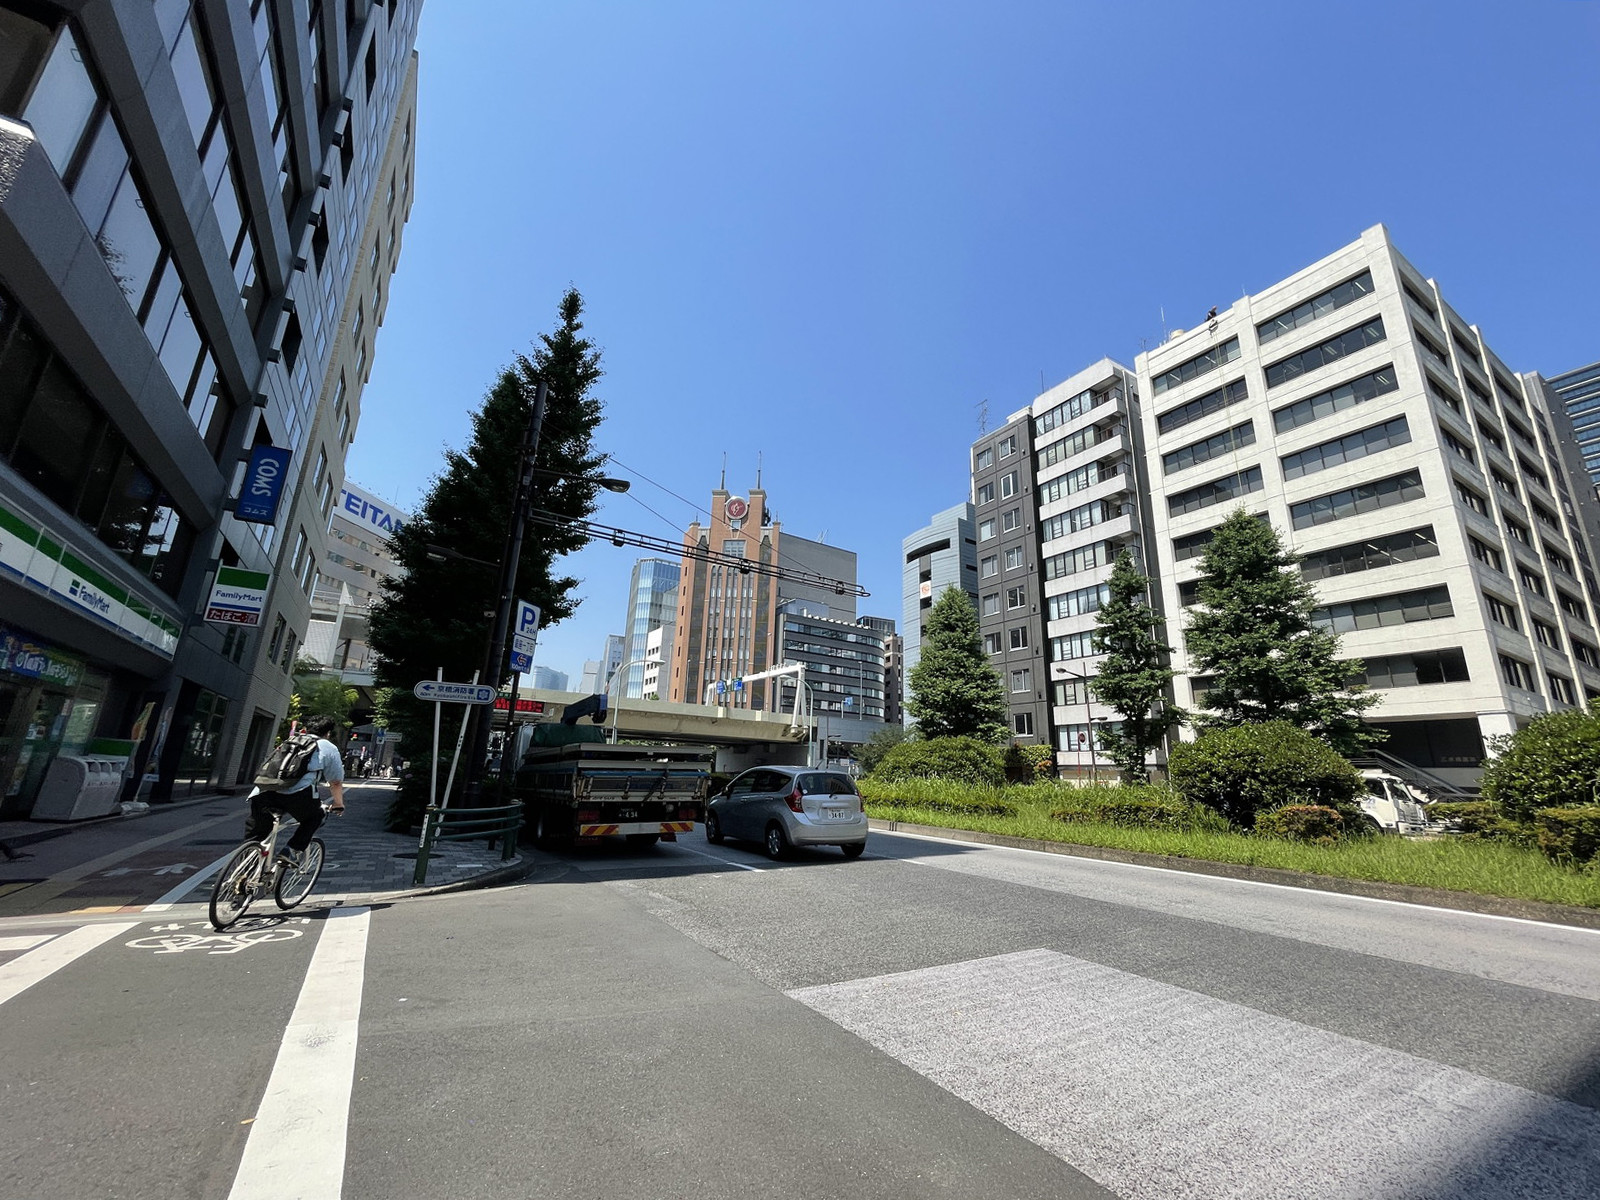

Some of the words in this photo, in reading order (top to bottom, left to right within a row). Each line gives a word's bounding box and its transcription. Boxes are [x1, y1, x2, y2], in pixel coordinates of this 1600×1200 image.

[251, 458, 280, 497] COMS
[78, 585, 110, 614] FamilyMart
[215, 589, 263, 602] FamilyMart
[520, 606, 536, 632] P
